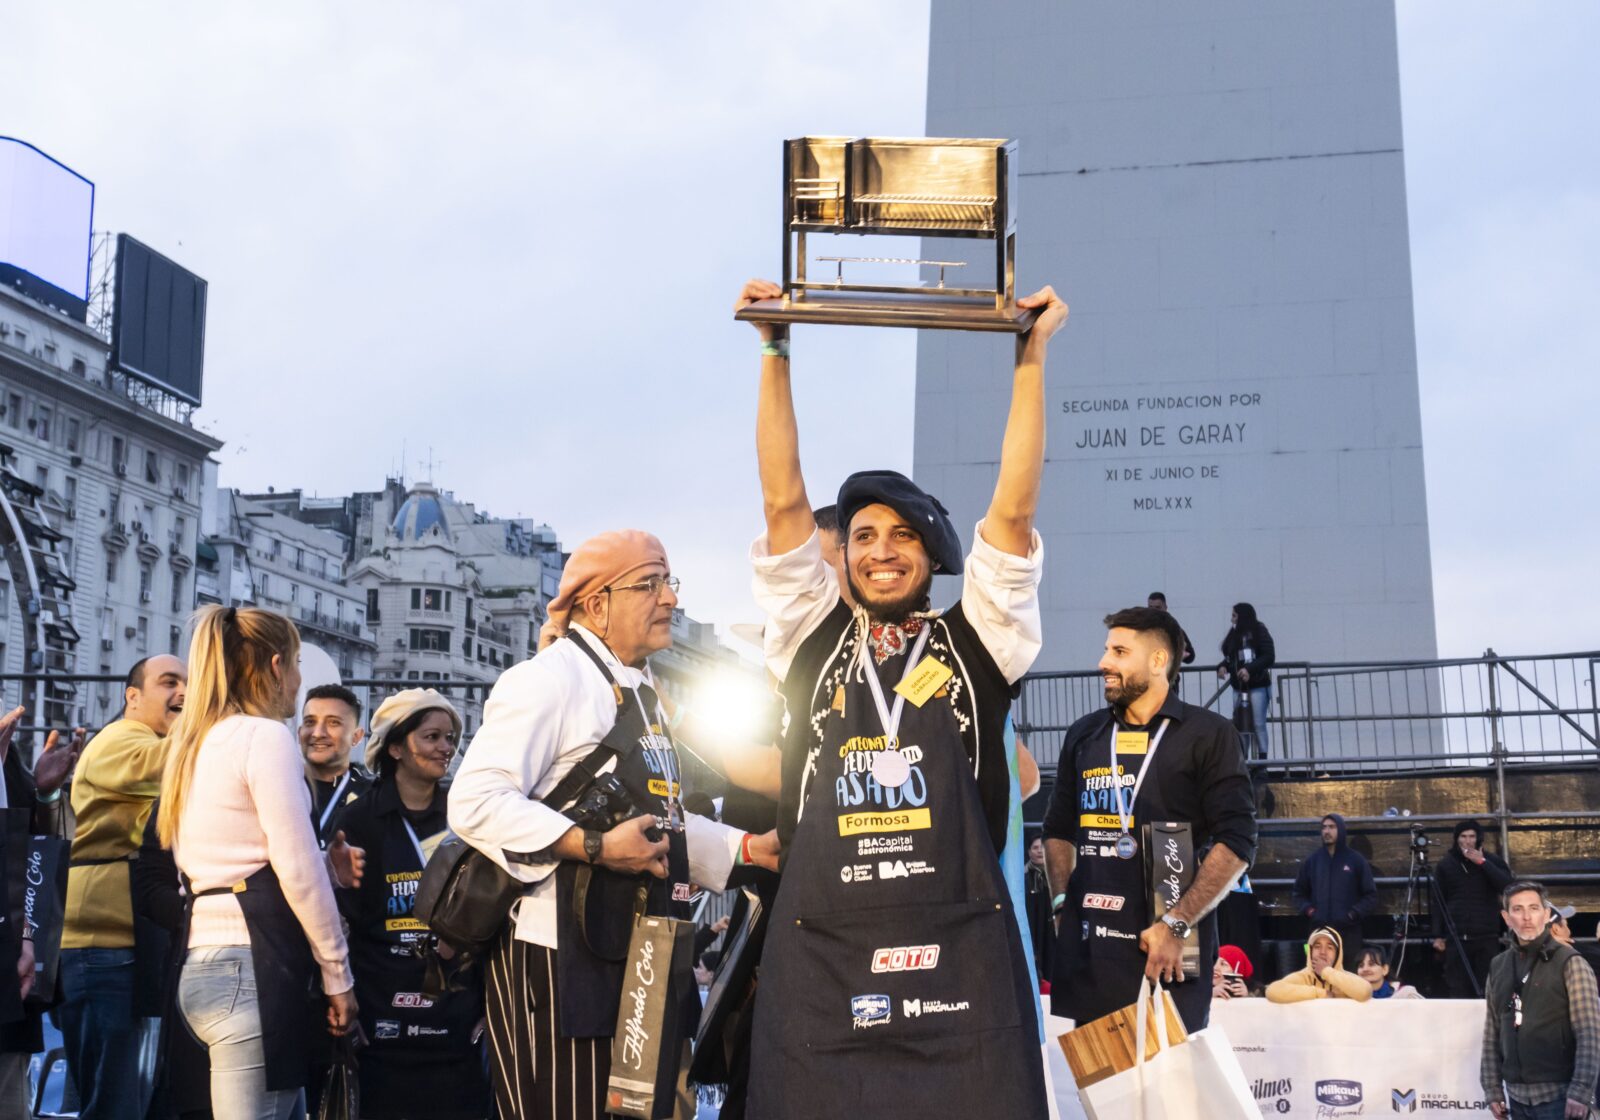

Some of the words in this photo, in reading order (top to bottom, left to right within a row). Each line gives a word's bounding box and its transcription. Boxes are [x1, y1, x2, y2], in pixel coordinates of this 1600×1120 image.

[1062, 400, 1129, 413] SEGUNDA
[1137, 395, 1222, 410] FUNDACION
[1229, 393, 1261, 407] POR
[1075, 427, 1127, 449] JUAN
[1140, 426, 1166, 447] DE
[1178, 423, 1246, 445] GARAY
[1105, 469, 1118, 481] XI
[1124, 468, 1142, 481] DE
[1149, 466, 1194, 480] JUNIO
[1201, 465, 1219, 479] DE
[1133, 497, 1192, 511] MDLXXX
[846, 813, 910, 829] Formosa
[1096, 816, 1122, 825] Chac
[858, 835, 913, 848] #BACapital
[878, 860, 909, 879] BA
[1083, 893, 1125, 910] COTO
[871, 944, 940, 973] COTO
[623, 986, 649, 1070] Alfredo
[1317, 1084, 1360, 1098] Milkaut
